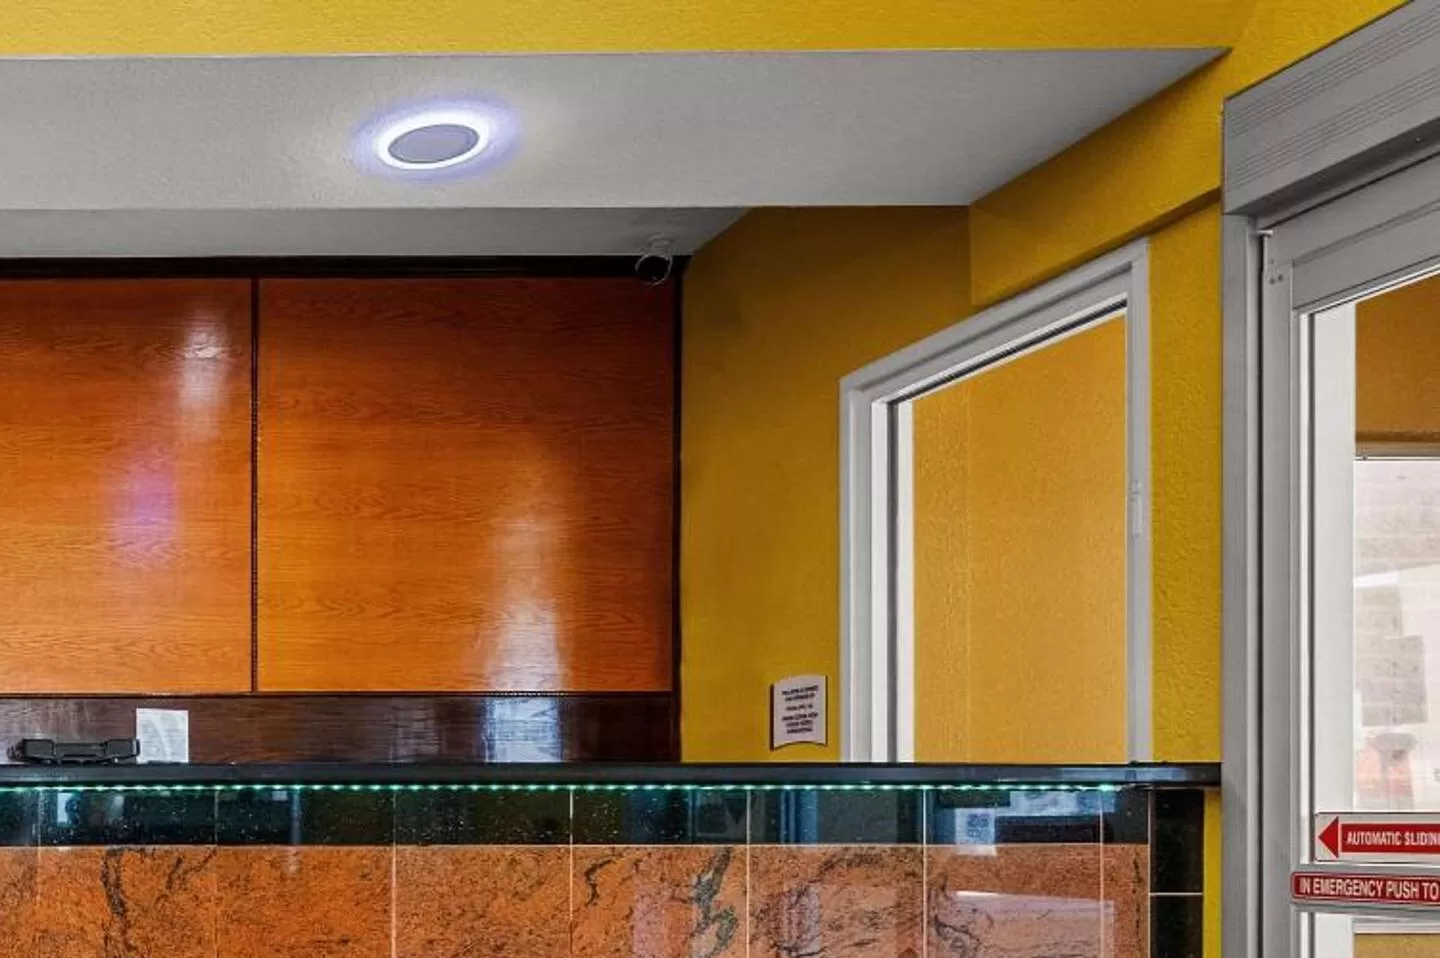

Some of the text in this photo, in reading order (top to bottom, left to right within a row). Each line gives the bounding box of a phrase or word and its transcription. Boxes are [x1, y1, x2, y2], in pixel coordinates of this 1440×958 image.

[1347, 831, 1401, 846] AUTOMATIC
[1301, 877, 1440, 901] IN EMERGENCY PUSH TO
